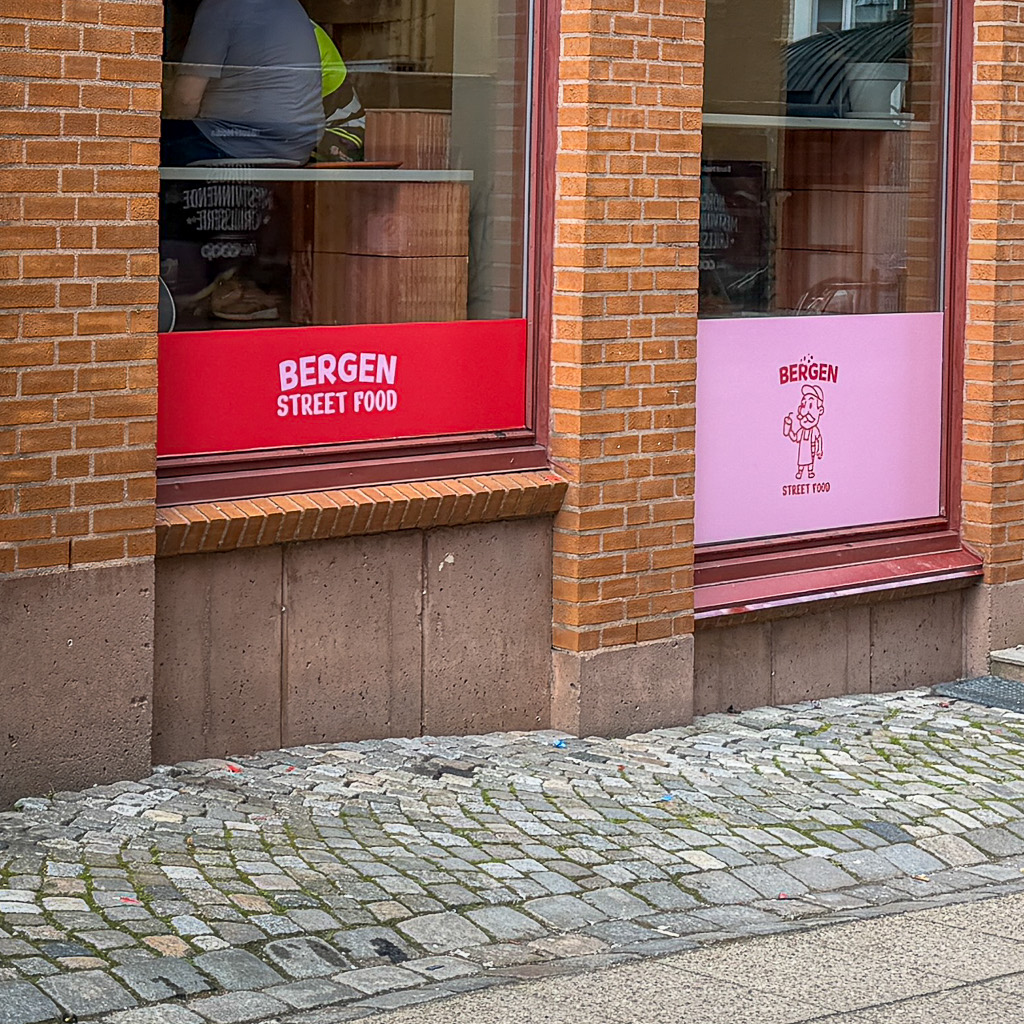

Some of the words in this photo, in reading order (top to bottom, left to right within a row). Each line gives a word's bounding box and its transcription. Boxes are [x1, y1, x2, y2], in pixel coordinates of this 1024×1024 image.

[278, 352, 398, 392] BERGEN
[779, 363, 839, 385] BERGEN
[277, 391, 347, 417] STREET
[353, 389, 398, 414] FOOD
[782, 483, 811, 496] STREET
[812, 482, 831, 494] FOOD
